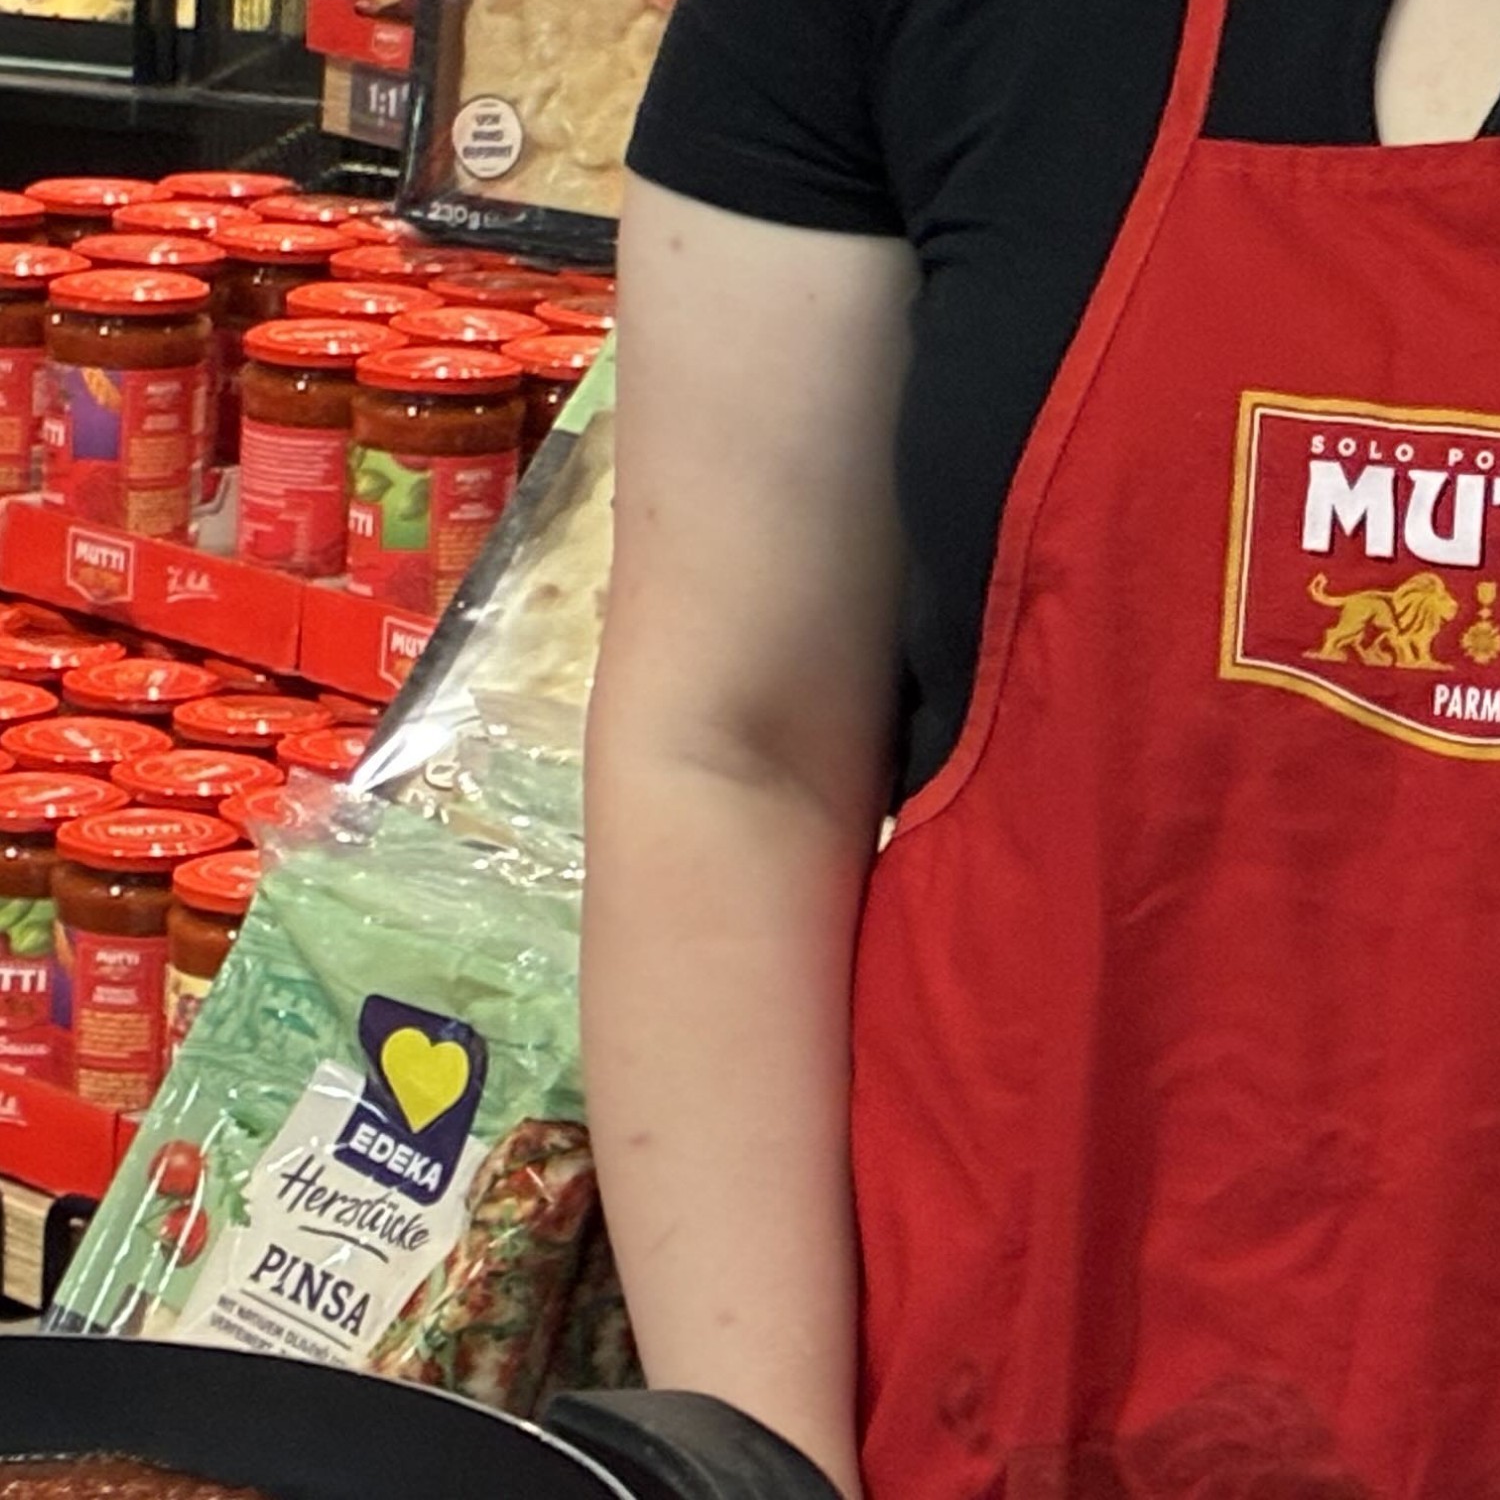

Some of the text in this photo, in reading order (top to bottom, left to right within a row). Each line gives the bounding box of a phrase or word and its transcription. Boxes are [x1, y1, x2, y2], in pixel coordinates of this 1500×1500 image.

[1311, 435, 1414, 463] SOLO
[74, 539, 127, 574] MUTTI
[0, 967, 48, 994] TTI
[348, 1122, 443, 1192] EDEKA
[278, 1154, 430, 1252] Herzstücke
[250, 1243, 371, 1337] PINSA
